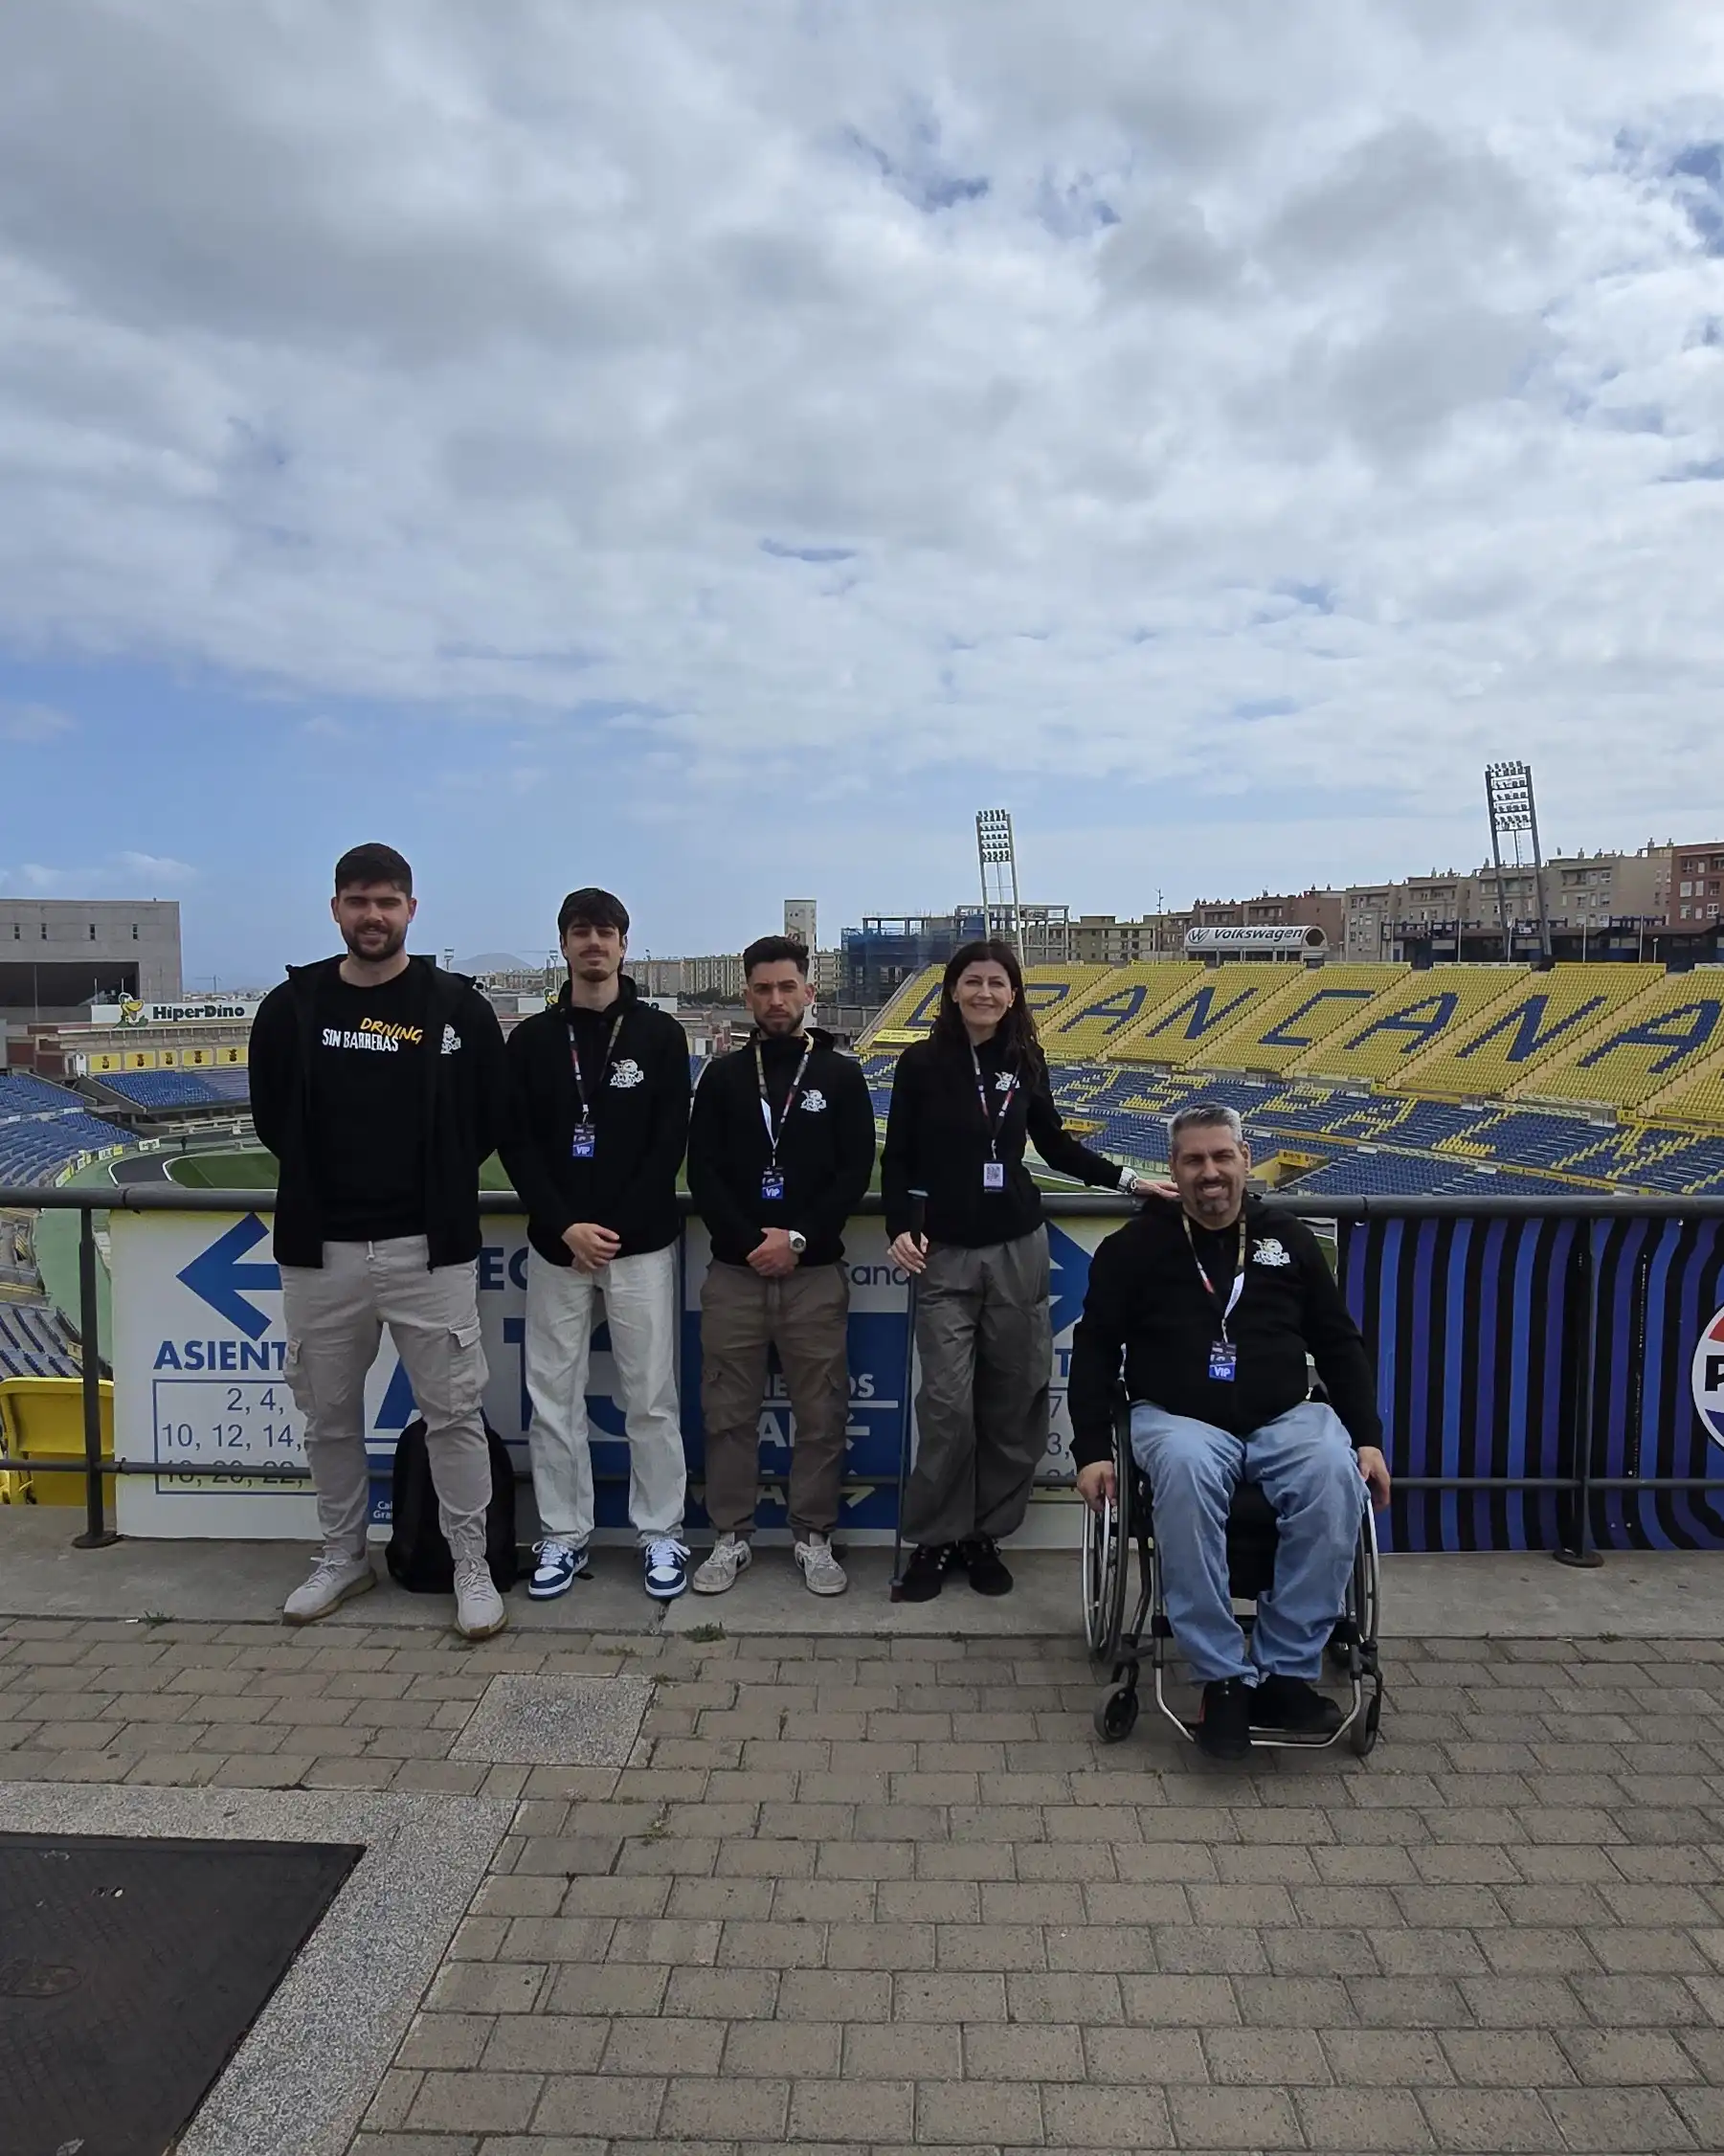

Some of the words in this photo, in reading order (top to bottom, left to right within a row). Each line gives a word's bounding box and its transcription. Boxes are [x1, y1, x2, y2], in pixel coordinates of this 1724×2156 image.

[1214, 928, 1303, 942] Volkswagen
[152, 1004, 246, 1022] HiperDino
[322, 1027, 343, 1047] SIN
[343, 1030, 399, 1052] BARRERAS
[576, 1146, 591, 1155] VIP
[766, 1187, 781, 1197] VIP
[1214, 1366, 1231, 1377] VIP
[162, 1423, 202, 1451] 10,
[212, 1424, 252, 1451] 12,
